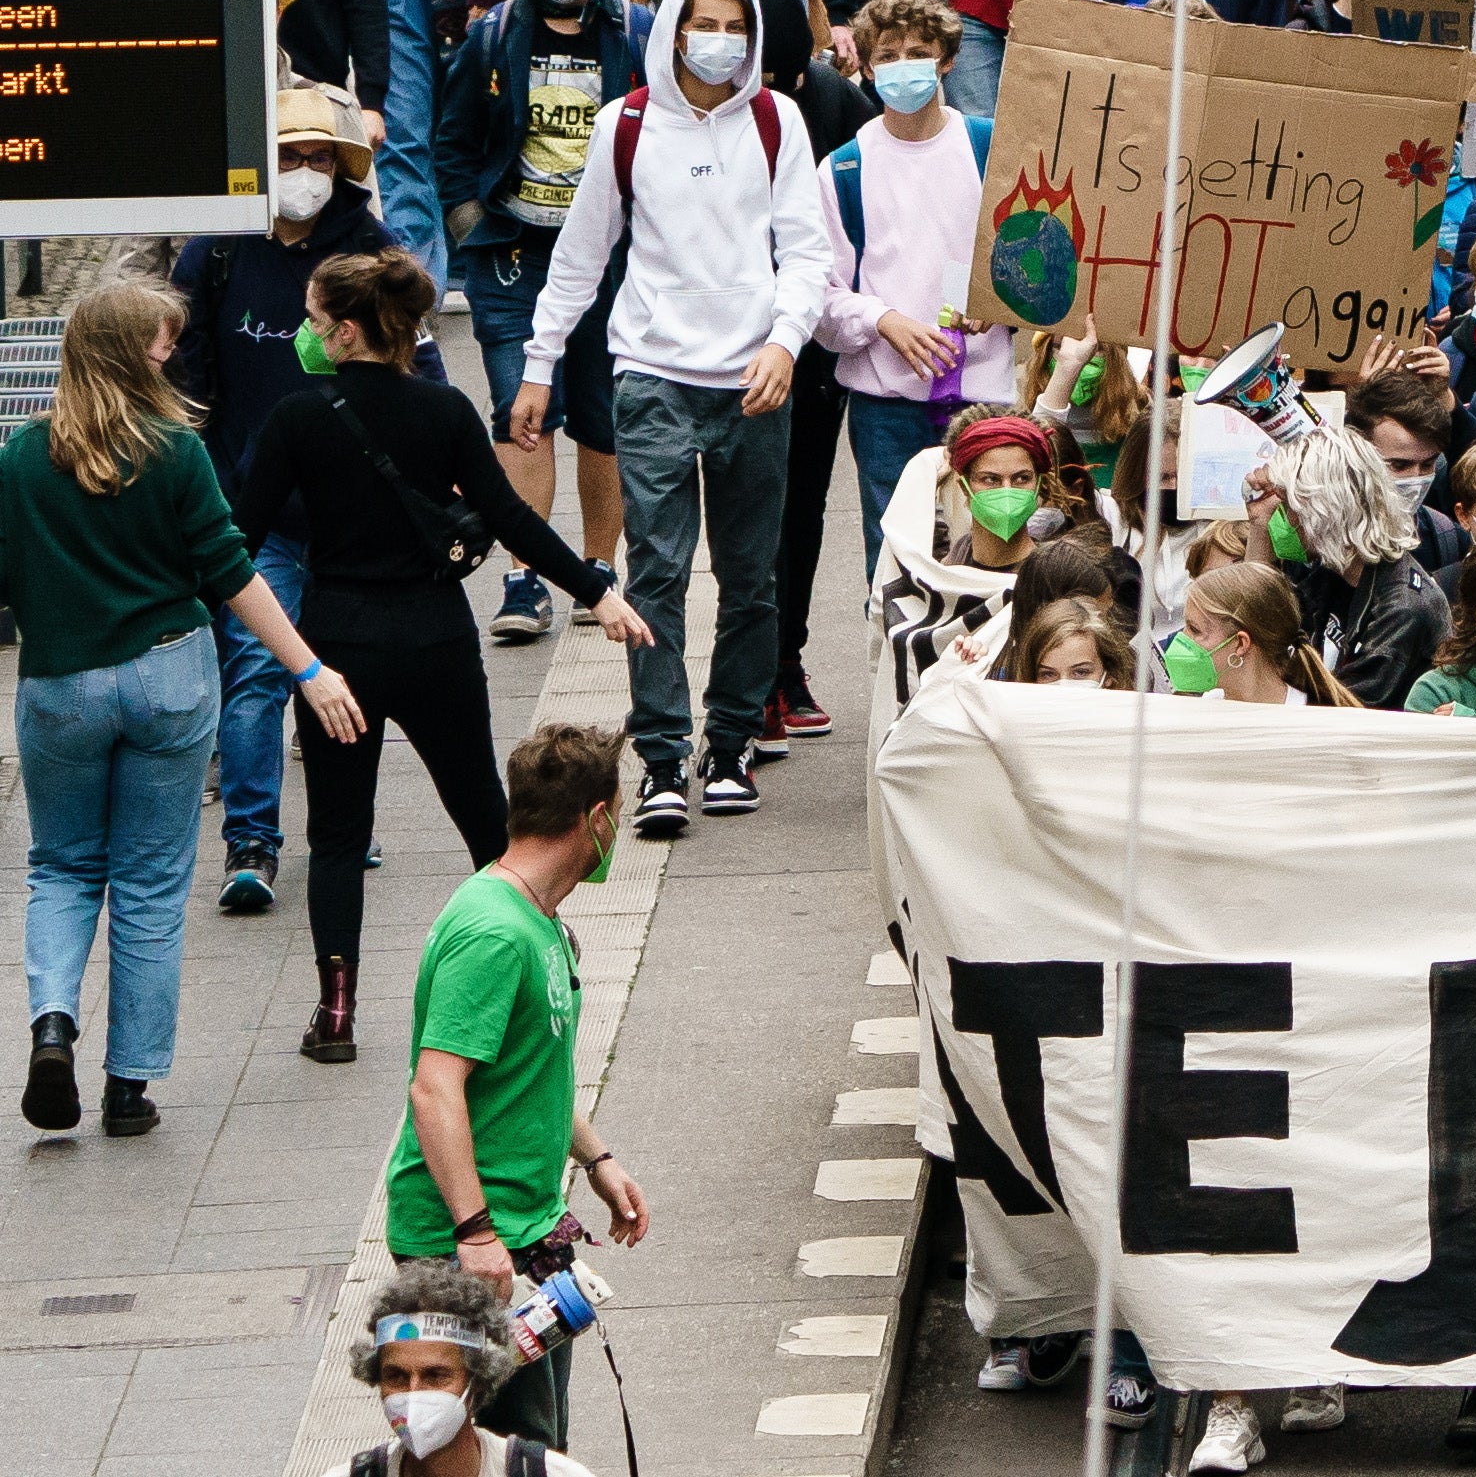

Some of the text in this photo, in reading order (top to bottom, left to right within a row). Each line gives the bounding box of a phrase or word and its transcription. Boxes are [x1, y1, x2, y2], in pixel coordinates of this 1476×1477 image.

[690, 165, 715, 178] OFF.
[233, 180, 255, 194] BVG
[1083, 205, 1296, 356] HOT
